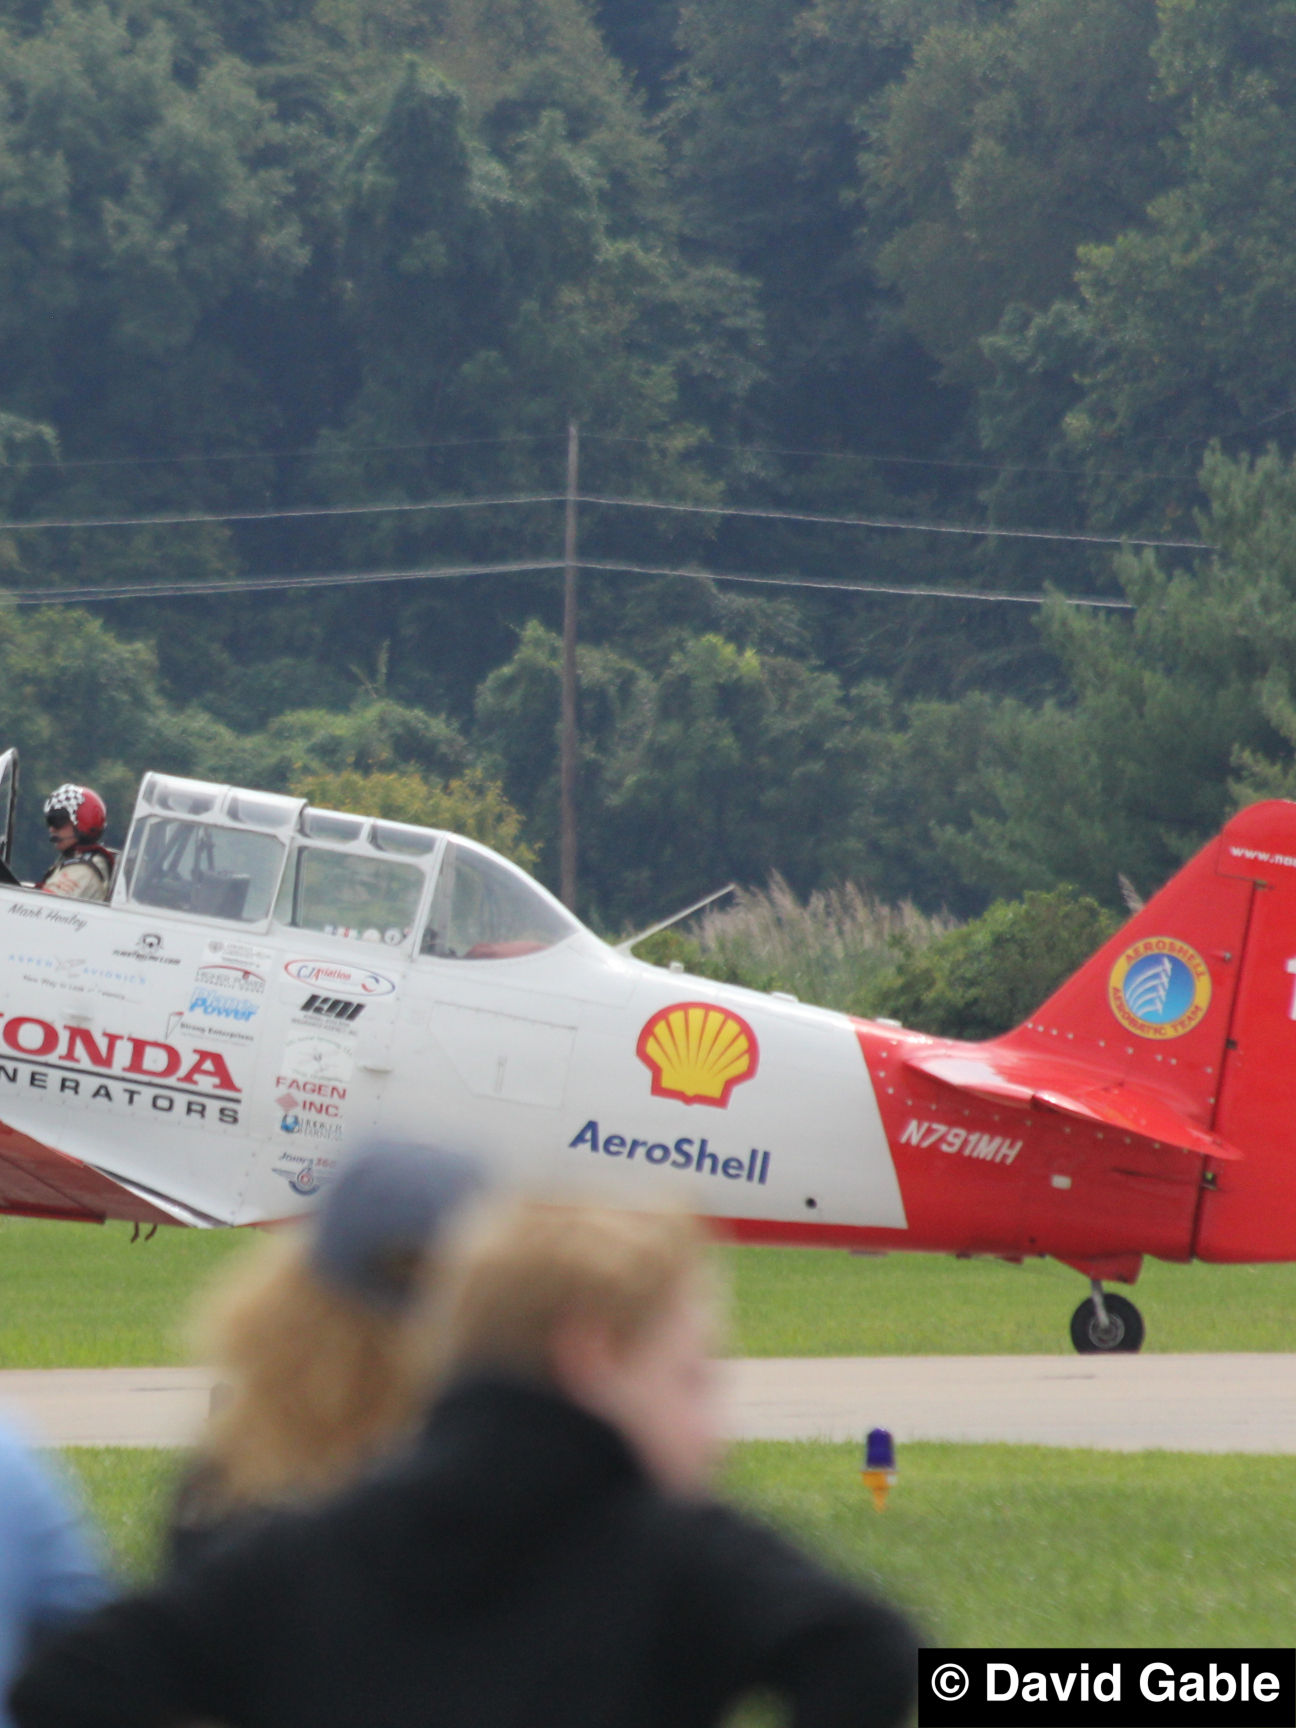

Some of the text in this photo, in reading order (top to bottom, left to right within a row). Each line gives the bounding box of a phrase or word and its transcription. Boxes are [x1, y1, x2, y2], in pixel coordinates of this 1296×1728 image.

[8, 903, 42, 919] Mark
[189, 997, 257, 1022] Power
[275, 1076, 347, 1100] FAGEN
[302, 1100, 343, 1119] INC.
[569, 1120, 771, 1185] AeroShell
[900, 1118, 1023, 1166] N791MH
